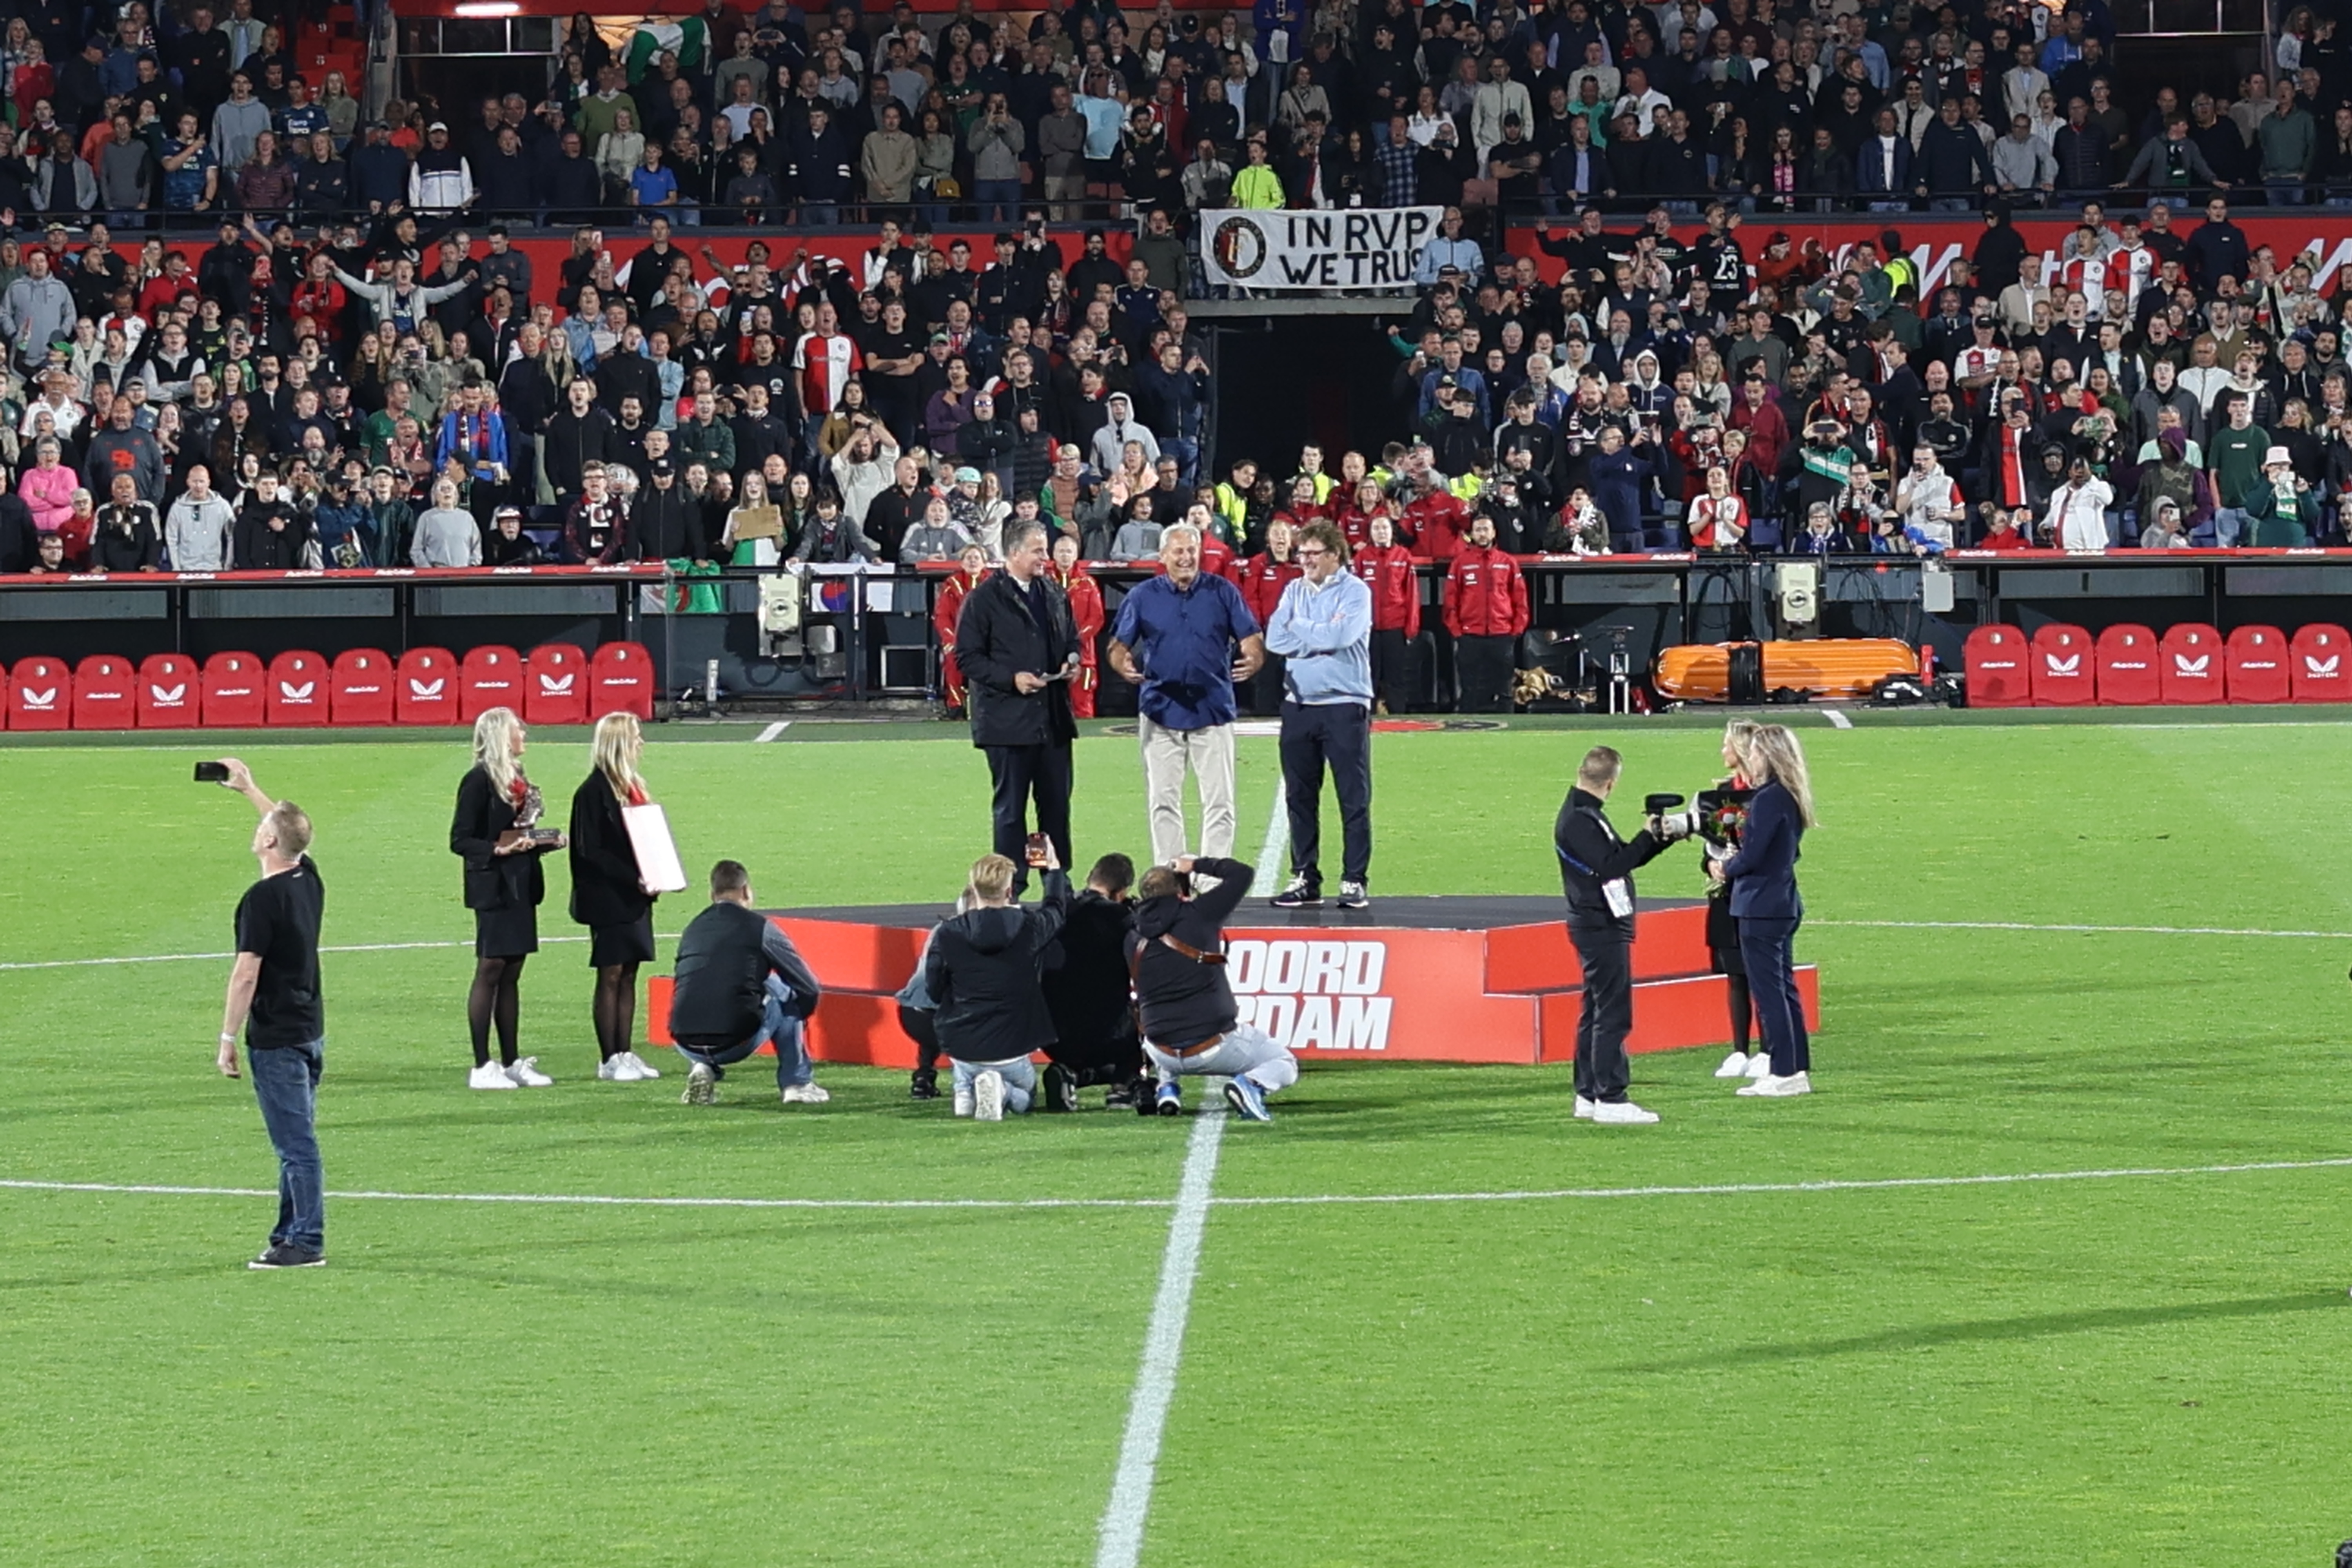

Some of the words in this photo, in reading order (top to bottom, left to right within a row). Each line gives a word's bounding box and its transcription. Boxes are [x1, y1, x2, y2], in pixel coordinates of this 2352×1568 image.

[1288, 217, 1331, 248] IN
[1345, 212, 1428, 251] RVP
[1714, 254, 1738, 279] 23
[1220, 940, 1386, 994] OORD
